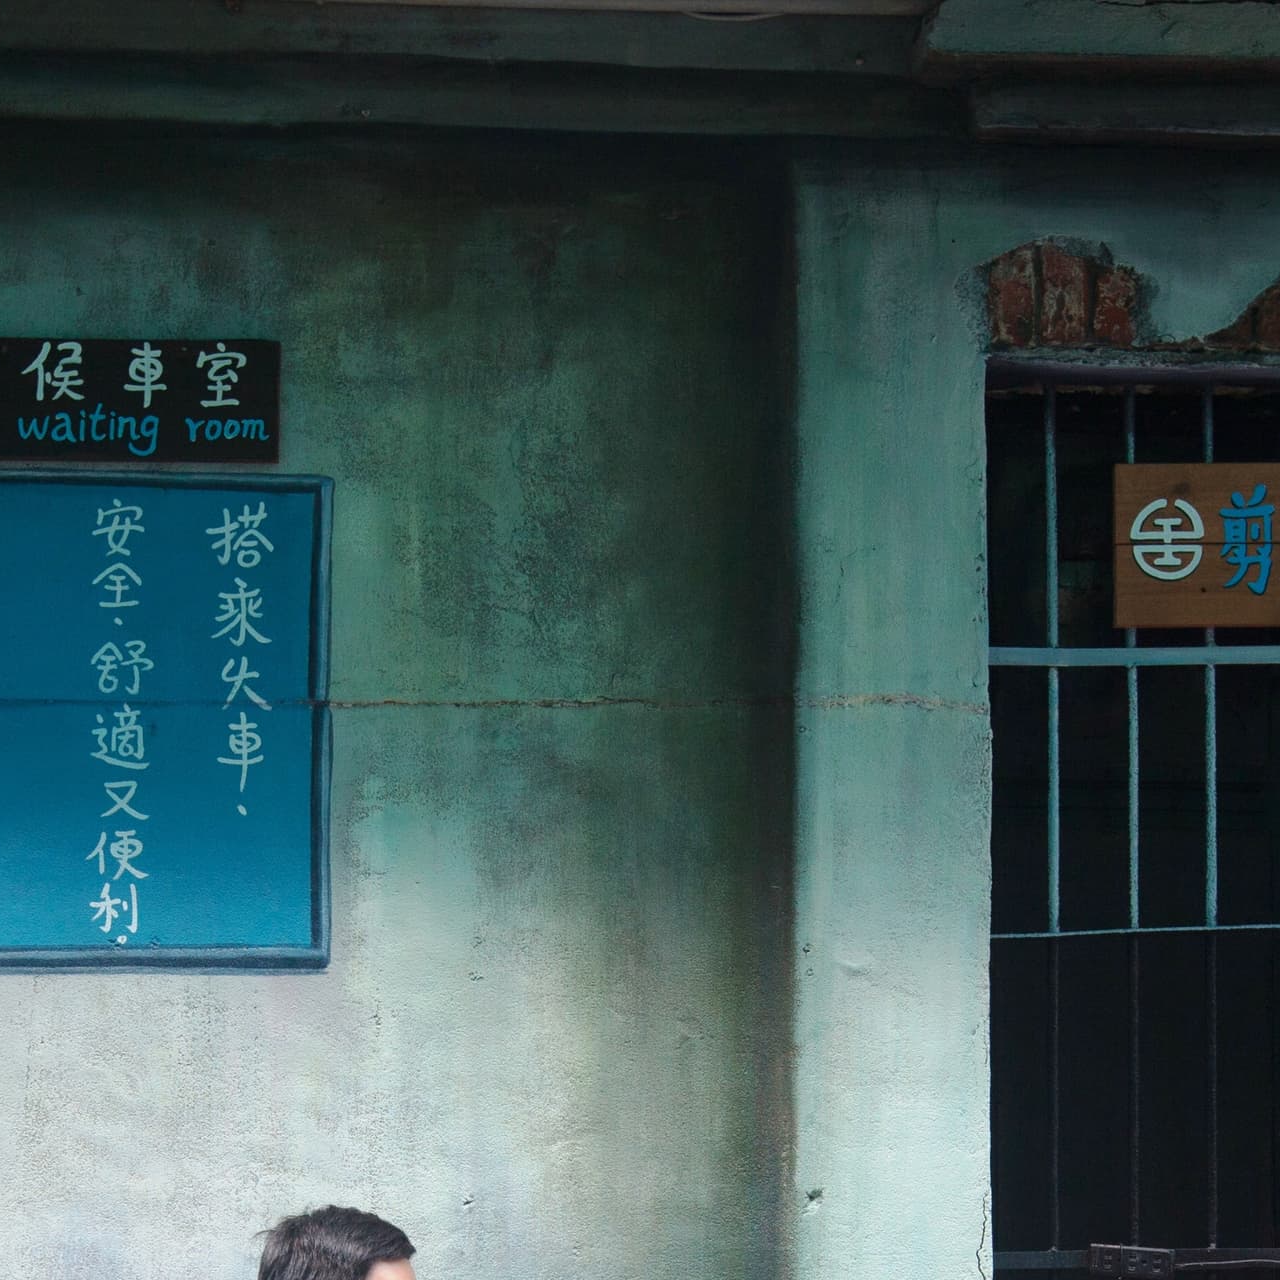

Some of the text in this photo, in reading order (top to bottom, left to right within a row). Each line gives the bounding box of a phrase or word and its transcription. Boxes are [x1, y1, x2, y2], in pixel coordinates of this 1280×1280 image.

[21, 340, 248, 409] 候車室
[17, 402, 270, 457] waiting room
